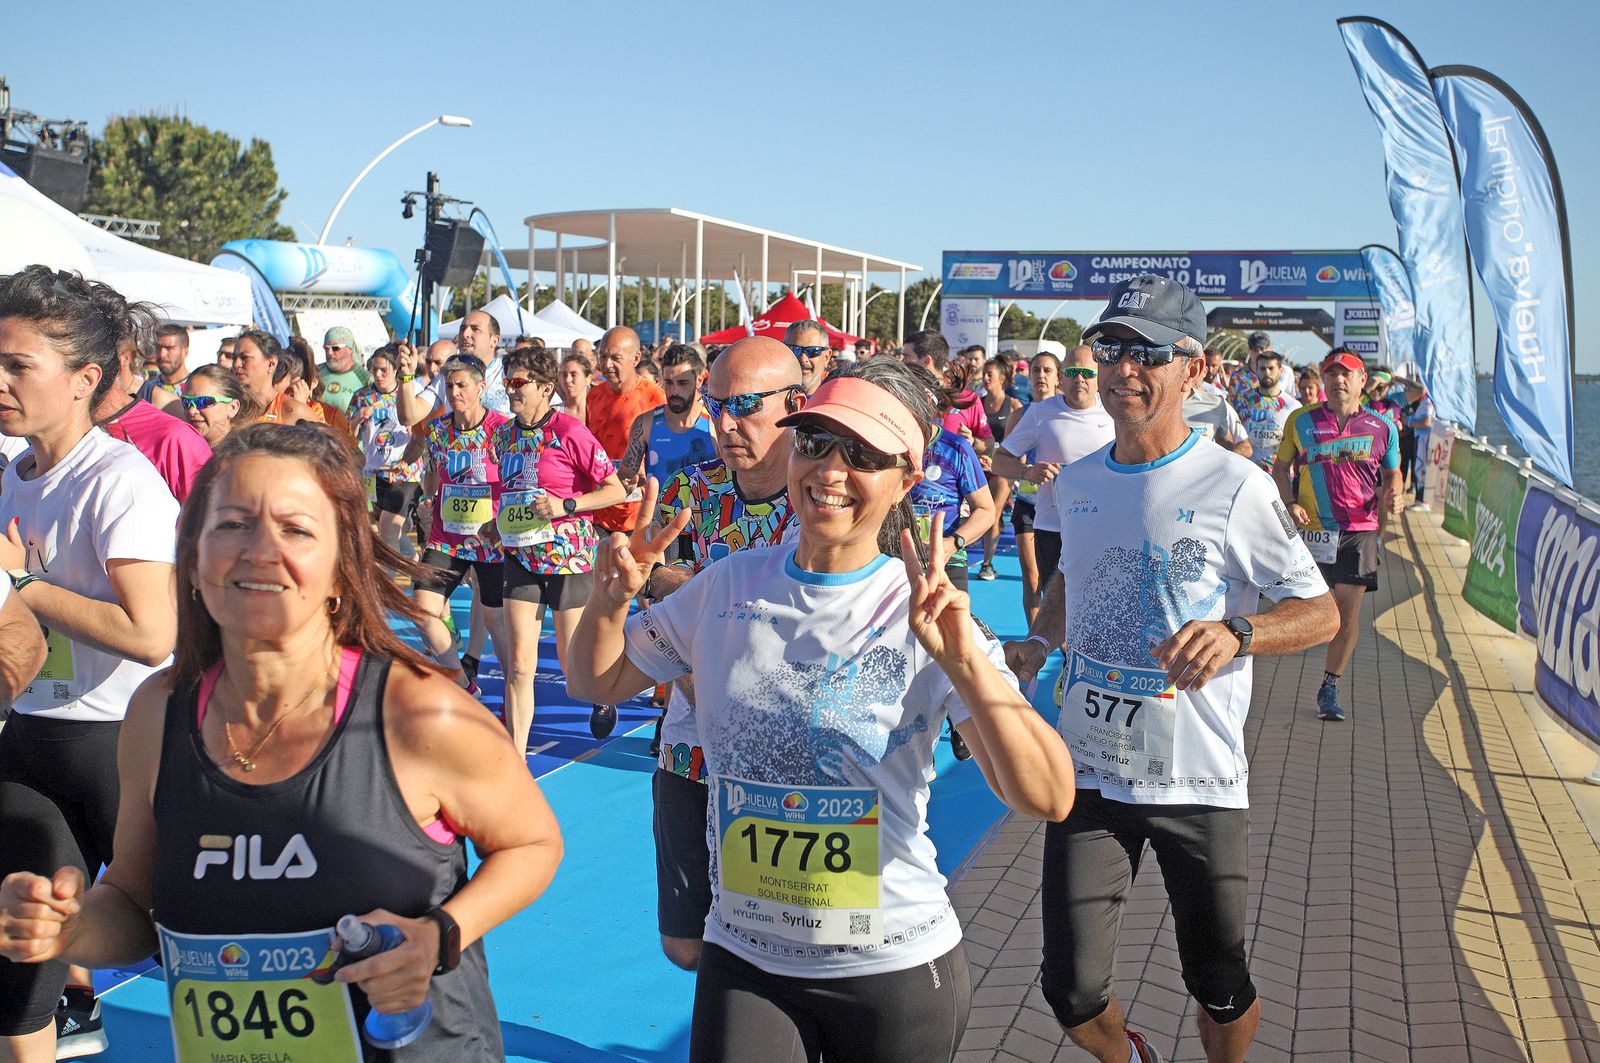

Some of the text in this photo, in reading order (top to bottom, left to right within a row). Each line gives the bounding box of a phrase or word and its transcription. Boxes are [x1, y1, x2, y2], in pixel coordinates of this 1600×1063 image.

[1091, 257, 1191, 269] CAMPEONATO
[1090, 272, 1106, 284] de
[1167, 270, 1190, 285] 10
[1196, 269, 1226, 286] km
[1240, 259, 1307, 293] 10 HUELVA
[1343, 268, 1373, 281] WiH
[1200, 286, 1226, 294] Master
[1118, 291, 1150, 309] CAT
[879, 412, 906, 436] ARTENGO
[453, 499, 477, 512] 837
[524, 494, 533, 502] 20
[508, 507, 534, 522] 845
[1300, 531, 1330, 543] 1003
[1084, 667, 1103, 680] HUELVA
[1130, 676, 1164, 693] 2023
[1084, 689, 1142, 728] 577
[1090, 725, 1132, 742] FRANCISCO
[1101, 751, 1130, 765] Syrluz
[726, 781, 778, 815] 10 HUELVA
[784, 812, 805, 820] WiHu
[817, 798, 864, 818] 2023
[193, 833, 318, 881] FILA
[741, 823, 852, 874] 1778
[760, 875, 829, 893] MONTSERRAT
[757, 888, 833, 907] SOLER BERNAL
[733, 907, 774, 924] HYUNDAI
[782, 911, 822, 929] Syrluz
[178, 949, 216, 967] HUELVA
[259, 947, 316, 973] 2023
[928, 960, 941, 989] DOMYO
[184, 987, 315, 1041] 1846
[211, 1051, 292, 1063] MARIA BELLA
